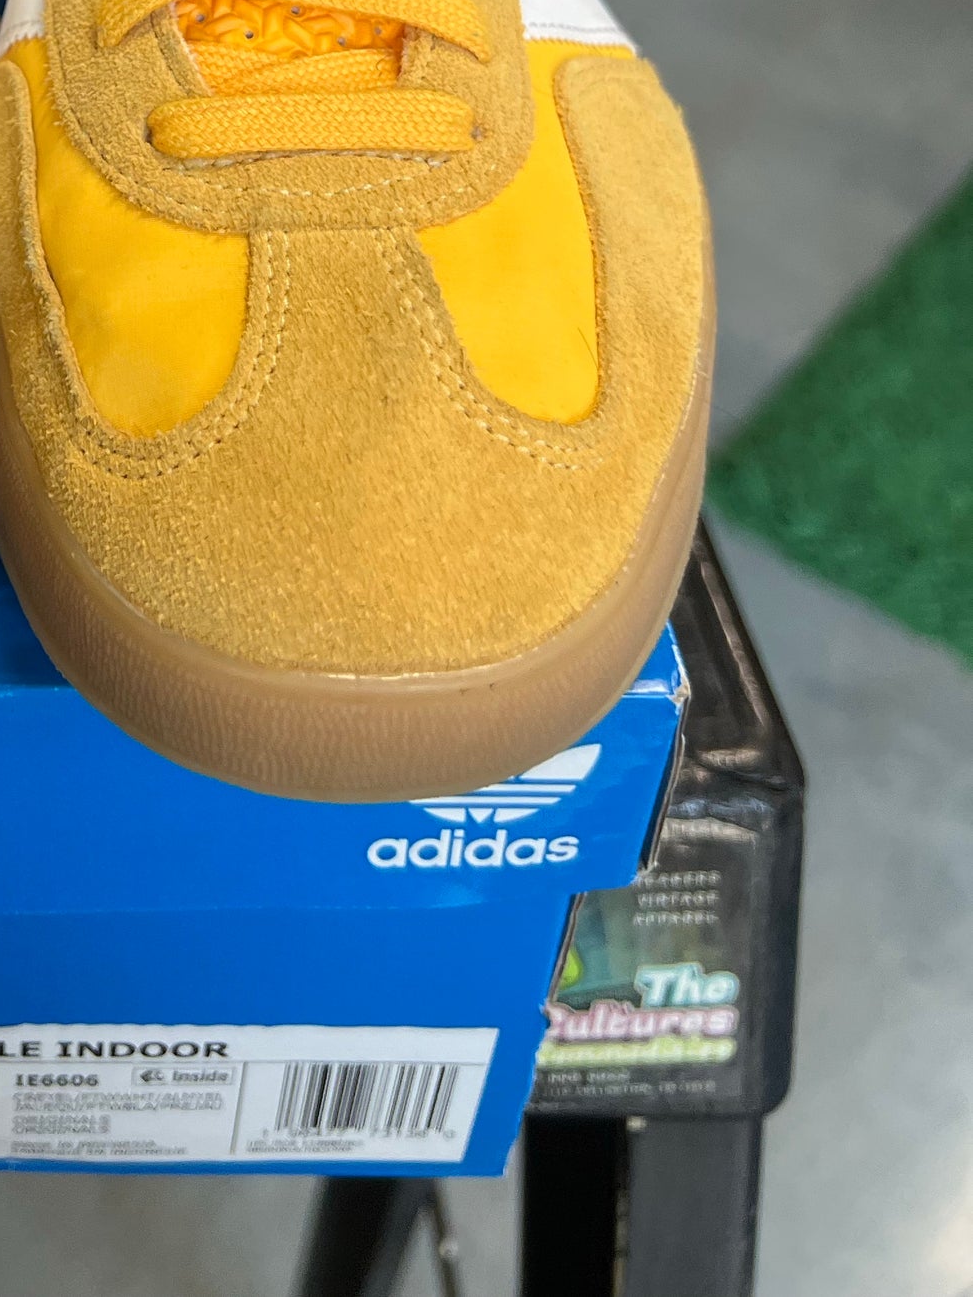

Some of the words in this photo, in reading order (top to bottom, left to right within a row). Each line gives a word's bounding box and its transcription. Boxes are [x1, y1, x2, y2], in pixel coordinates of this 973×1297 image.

[366, 829, 581, 869] adidas
[639, 964, 738, 1007] The
[56, 1040, 229, 1058] INDOOR
[15, 1073, 100, 1087] IE6606
